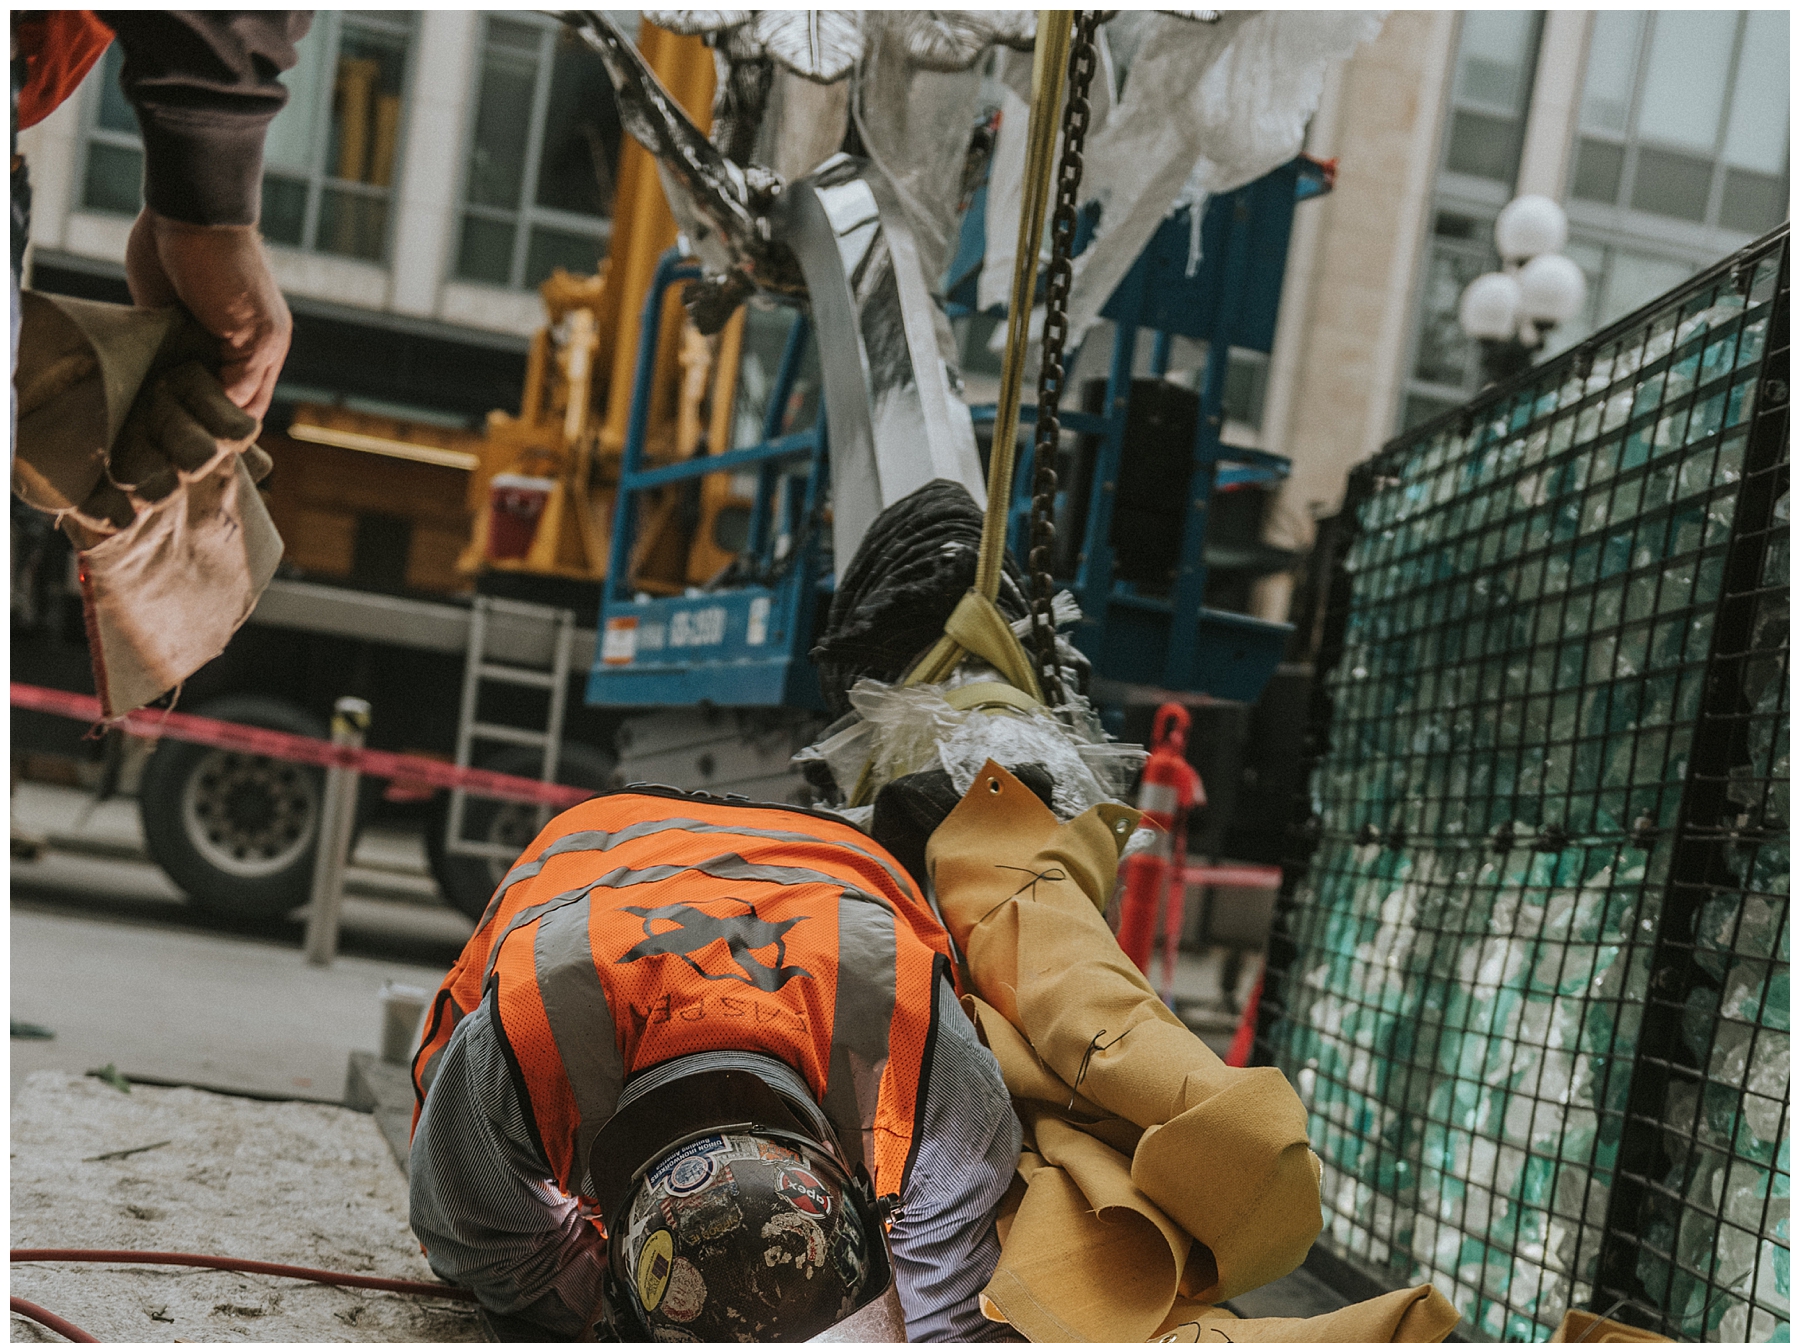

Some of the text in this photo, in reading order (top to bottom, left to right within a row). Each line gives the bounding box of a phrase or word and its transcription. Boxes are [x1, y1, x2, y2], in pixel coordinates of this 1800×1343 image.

[682, 1138, 710, 1152] Building
[698, 1140, 723, 1152] UNION
[650, 1148, 697, 1184] IRONWORKERS
[656, 1150, 681, 1171] America
[787, 1180, 825, 1205] apex
